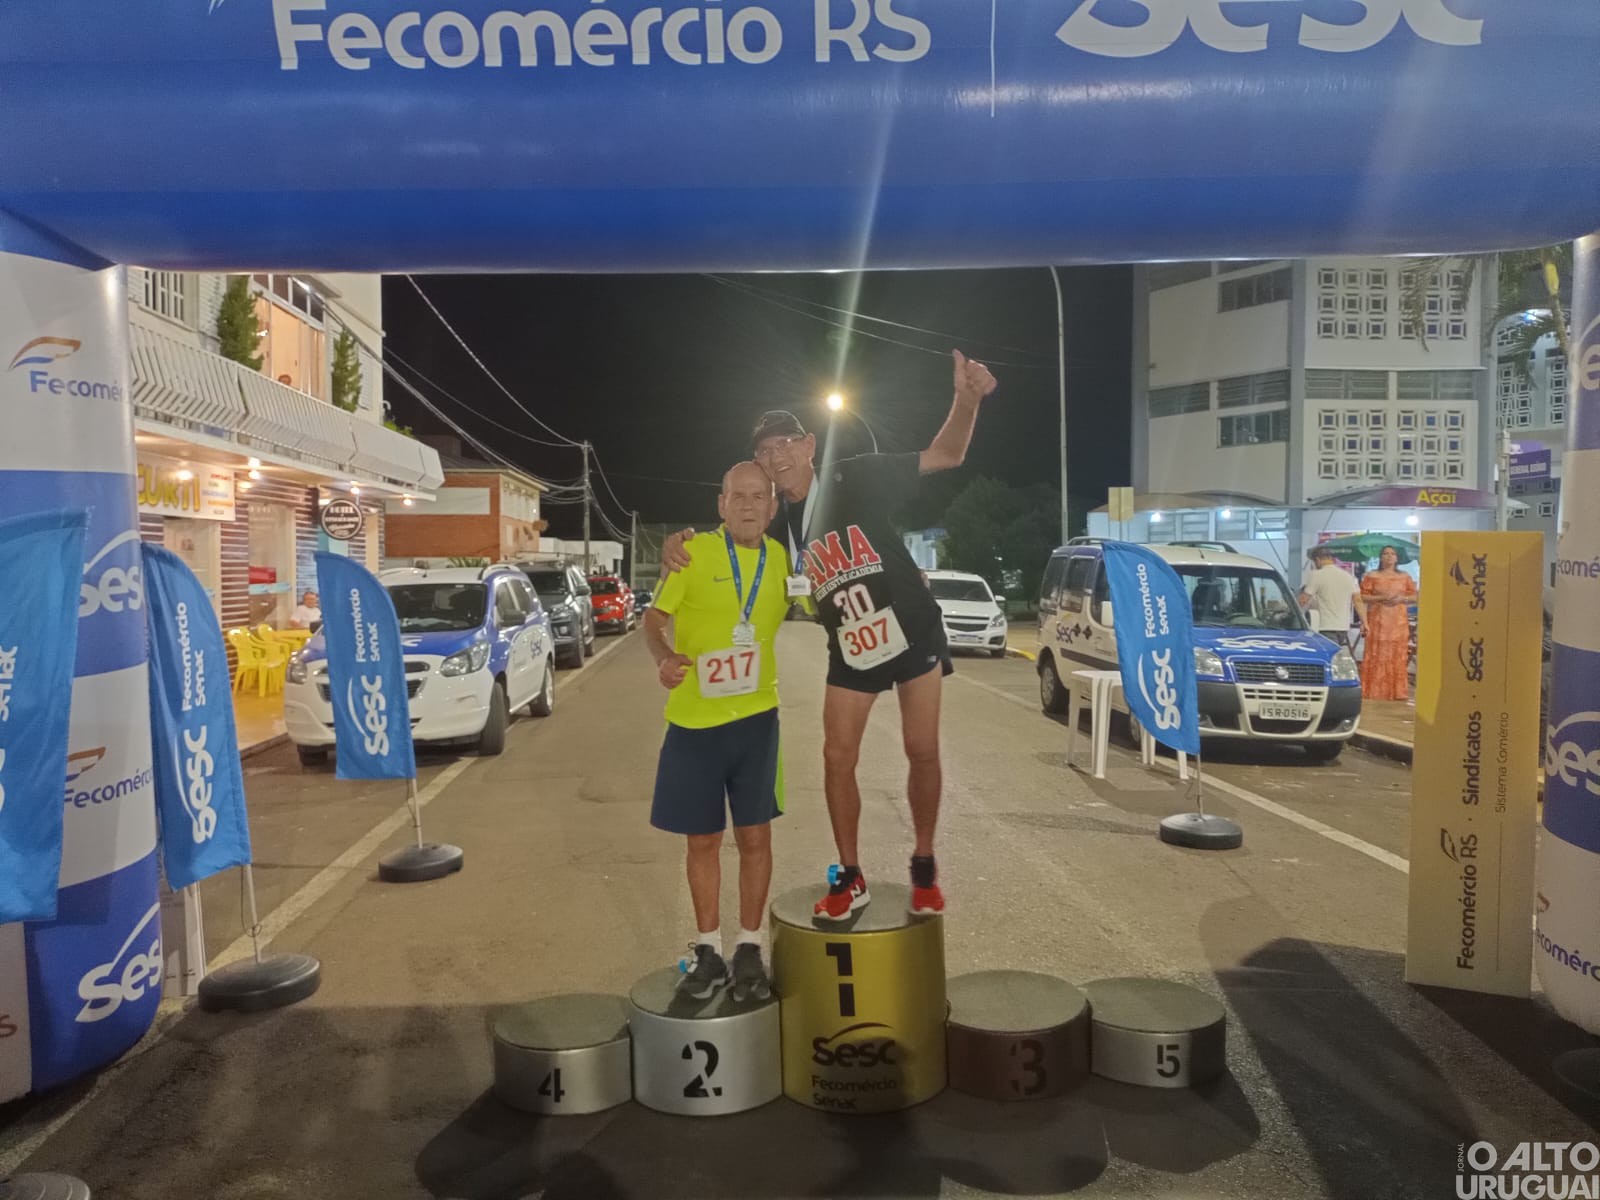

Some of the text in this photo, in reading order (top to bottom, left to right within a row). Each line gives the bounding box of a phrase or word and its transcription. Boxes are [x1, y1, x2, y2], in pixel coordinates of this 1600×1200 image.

[814, 0, 931, 63] RS
[833, 583, 876, 625] 30
[1136, 563, 1157, 638] Fecomércio
[1467, 553, 1487, 611] Senac
[349, 588, 367, 663] Fecomércio
[844, 617, 889, 657] 307
[176, 602, 193, 711] Fecomércio
[706, 651, 755, 684] 217
[1462, 711, 1482, 806] Sindicatos
[1495, 766, 1507, 814] Sistema
[1460, 834, 1478, 859] RS
[1456, 864, 1477, 971] Fecomércio
[826, 943, 855, 1017] 1
[681, 1041, 723, 1098] 2
[812, 1026, 898, 1068] Sesc
[1010, 1038, 1048, 1095] 3
[1156, 1044, 1181, 1078] 5
[537, 1067, 566, 1103] 4
[811, 1074, 897, 1093] Fecomércio
